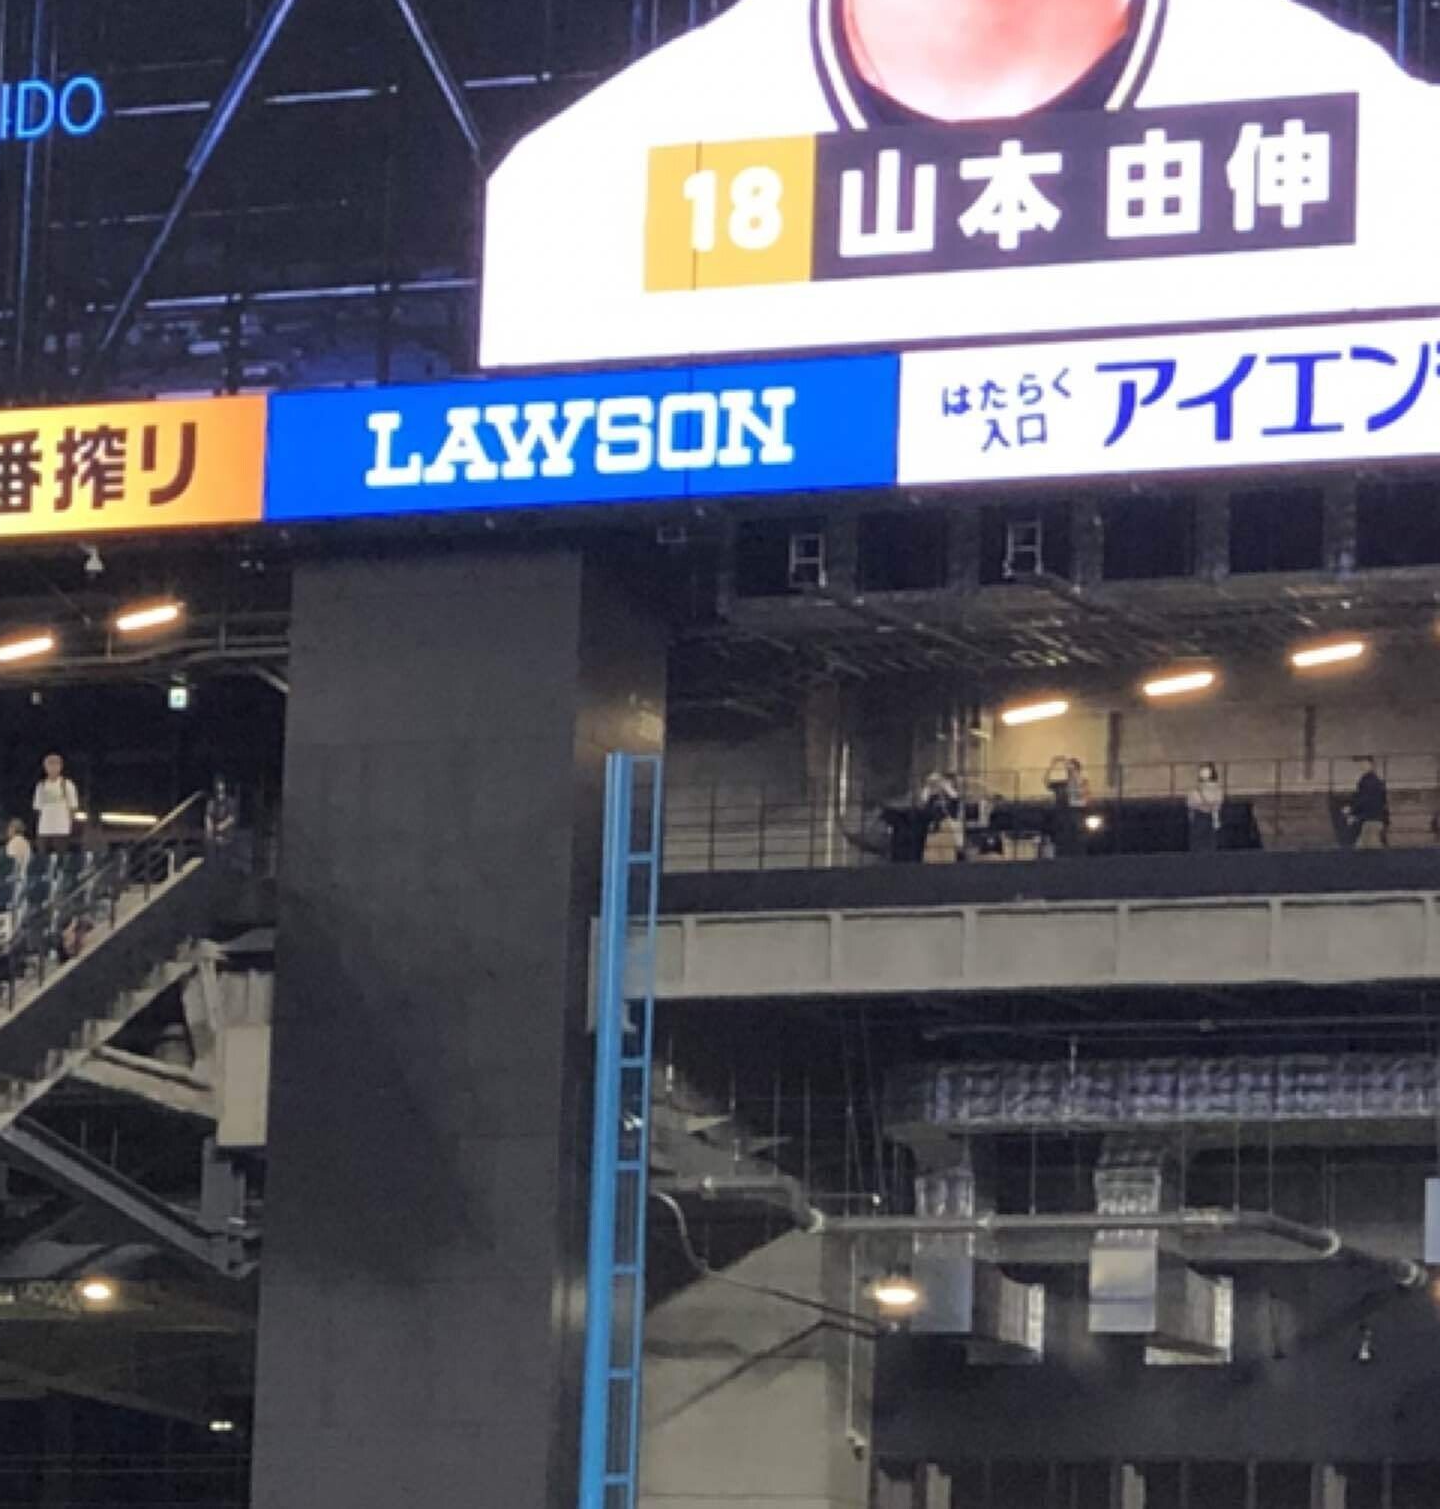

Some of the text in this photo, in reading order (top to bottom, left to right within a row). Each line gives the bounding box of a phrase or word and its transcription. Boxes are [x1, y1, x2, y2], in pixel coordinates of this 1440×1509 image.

[684, 167, 782, 251] 18
[943, 369, 1070, 422] はたらく
[366, 387, 795, 486] LAWSON
[982, 422, 1048, 452] 入口
